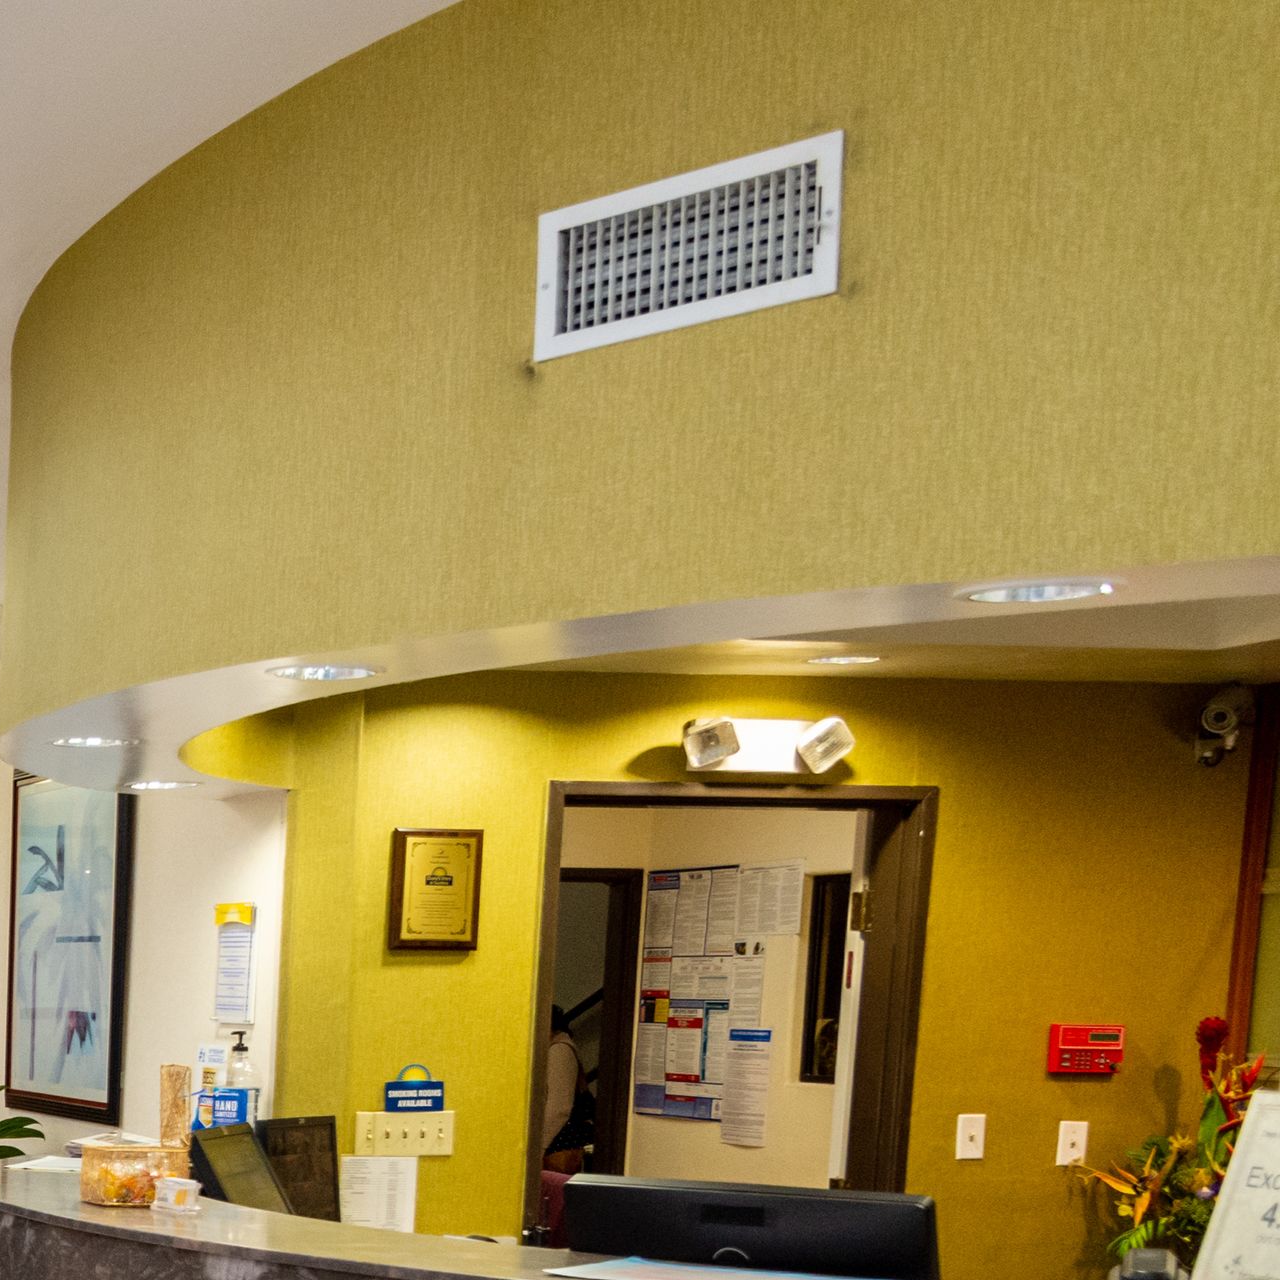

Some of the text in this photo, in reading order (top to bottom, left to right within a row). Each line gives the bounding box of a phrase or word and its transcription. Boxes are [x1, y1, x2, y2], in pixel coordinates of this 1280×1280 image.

[387, 1088, 442, 1098] SMOKING ROOMS
[214, 1099, 238, 1112] HAND
[397, 1099, 433, 1108] AVAILABLE
